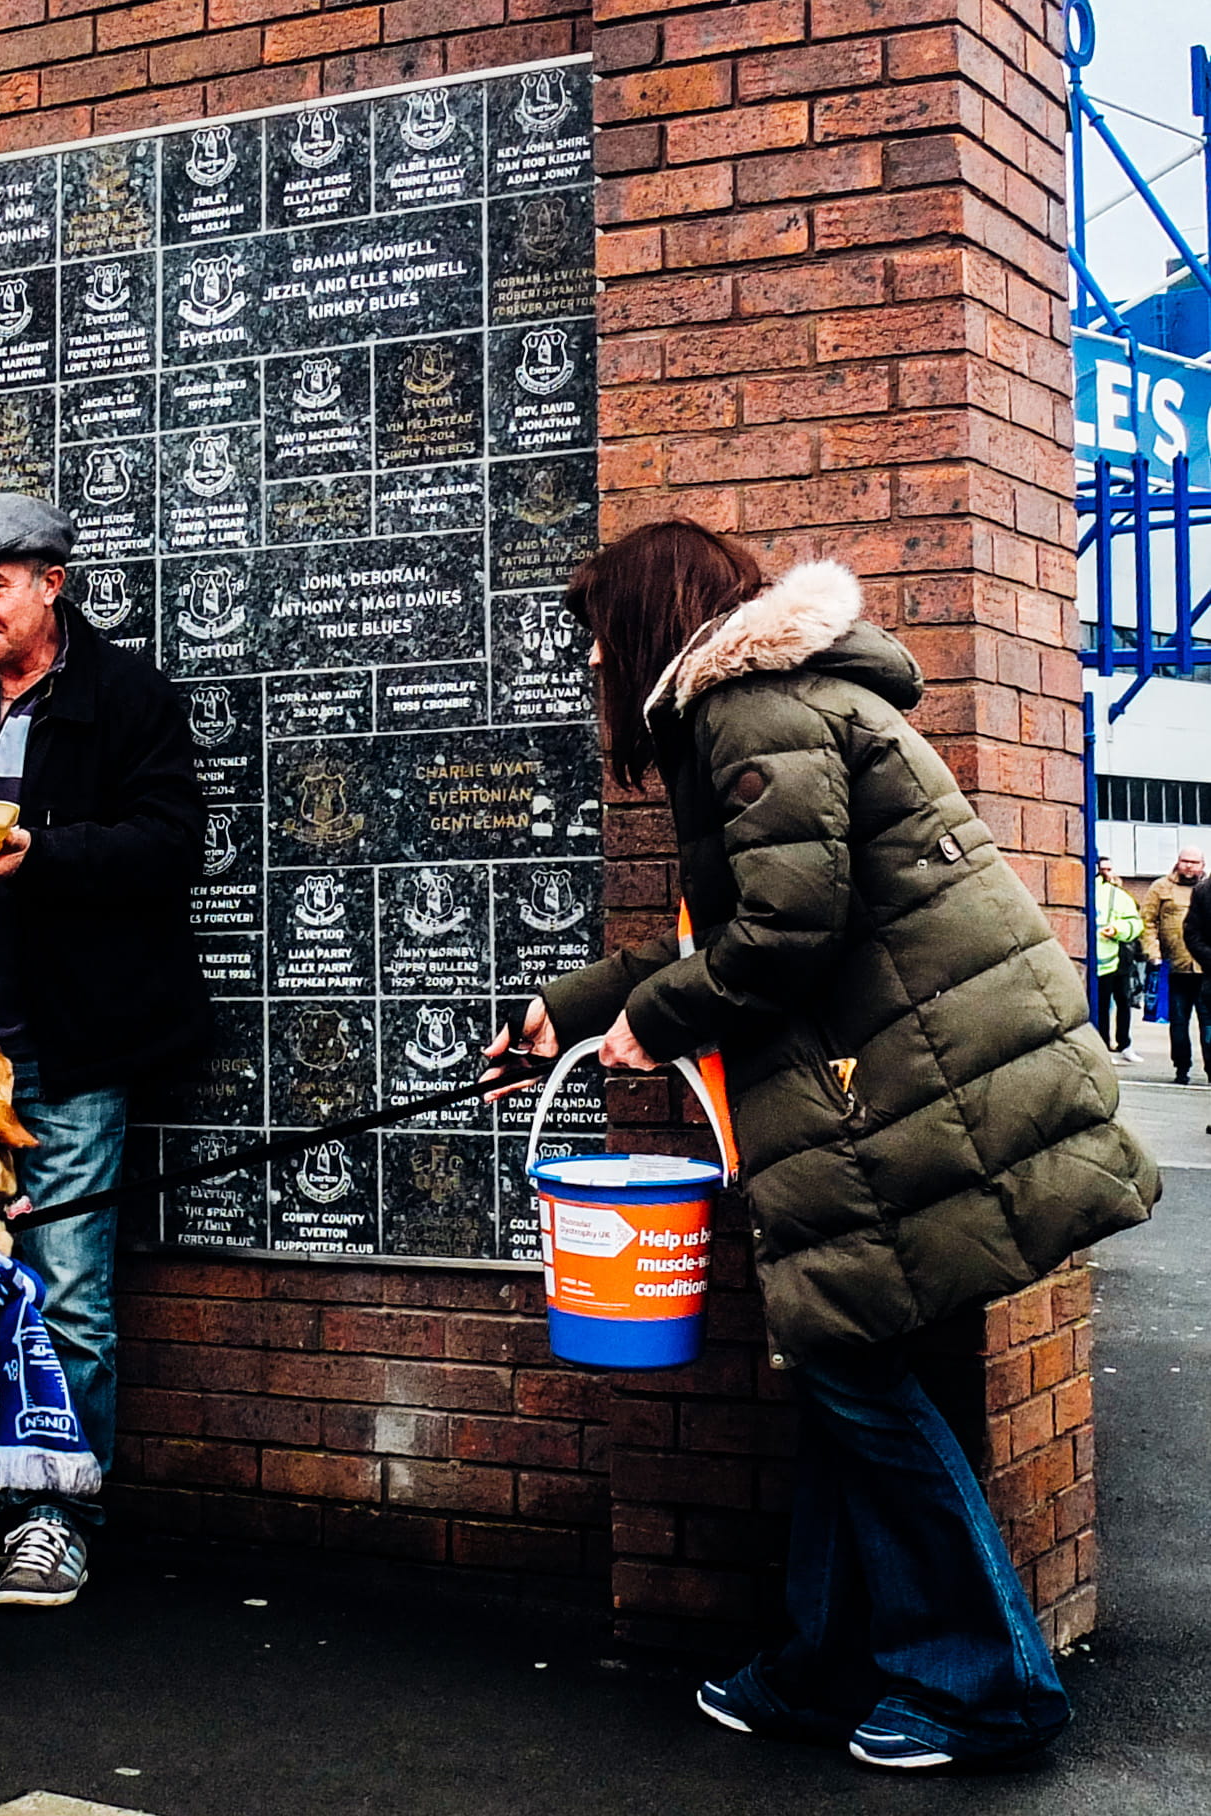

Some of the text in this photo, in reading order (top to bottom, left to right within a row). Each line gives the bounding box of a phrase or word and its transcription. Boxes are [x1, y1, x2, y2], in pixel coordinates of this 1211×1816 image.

[496, 159, 518, 173] DAN
[521, 157, 546, 170] ROB
[284, 173, 352, 193] AMELIE ROSE
[507, 165, 580, 186] ADAM JONNY
[8, 182, 33, 197] THE
[396, 183, 460, 201] TRUE BLUES
[5, 204, 35, 221] NOW
[292, 240, 436, 273] GRAHAM NODWELL
[262, 259, 467, 302] JEZEL AND ELLE NODWELL
[308, 291, 419, 319] KIRKBY BLUES
[84, 312, 129, 326] Everton
[179, 326, 245, 349] Everton
[67, 340, 147, 359] FOREVER A BLUE
[65, 353, 150, 374] LOVE YOU ALWAYS
[543, 401, 575, 415] DAVID
[519, 416, 581, 430] JONATHAN
[276, 433, 306, 444] DAVID
[518, 431, 572, 446] LEATHAM
[78, 525, 134, 540] AND FAMILY
[350, 566, 430, 588] DEBORAH,
[270, 599, 343, 618] ANTHONY
[362, 593, 401, 612] MAGI
[404, 589, 462, 607] DAVIES
[317, 618, 412, 639] TRUE BLUES
[178, 642, 245, 660] Everton
[512, 671, 584, 686] JERRY & LEE
[514, 686, 580, 701] O'SULLIVAN
[393, 697, 471, 712] ROSS CROMBIE
[415, 761, 543, 780] CHARLIE WYATT
[428, 788, 532, 806] EVERTONIAN
[430, 814, 530, 831] GENTLEMAN
[210, 885, 257, 895] SPENCER
[206, 899, 241, 909] FAMILY
[296, 928, 344, 941] Everton
[288, 948, 352, 959] LIAM PARRY
[517, 944, 555, 958] HARRY
[288, 963, 353, 974] ALEX PARRY
[430, 960, 479, 973] BULLENS
[521, 959, 586, 971] 1939 2003
[278, 977, 364, 988] STEPHEN PARRY
[503, 975, 531, 986] LOVE
[410, 1079, 455, 1092] MEMORY
[567, 1081, 589, 1094] FOY
[509, 1097, 532, 1108] DAD
[502, 1111, 553, 1123] EVERTN
[322, 1213, 364, 1225] COUNTY
[299, 1227, 348, 1239] EVERTON
[639, 1229, 682, 1251] Help
[683, 1231, 698, 1245] us
[275, 1239, 374, 1254] SUPPORTERS CLUB
